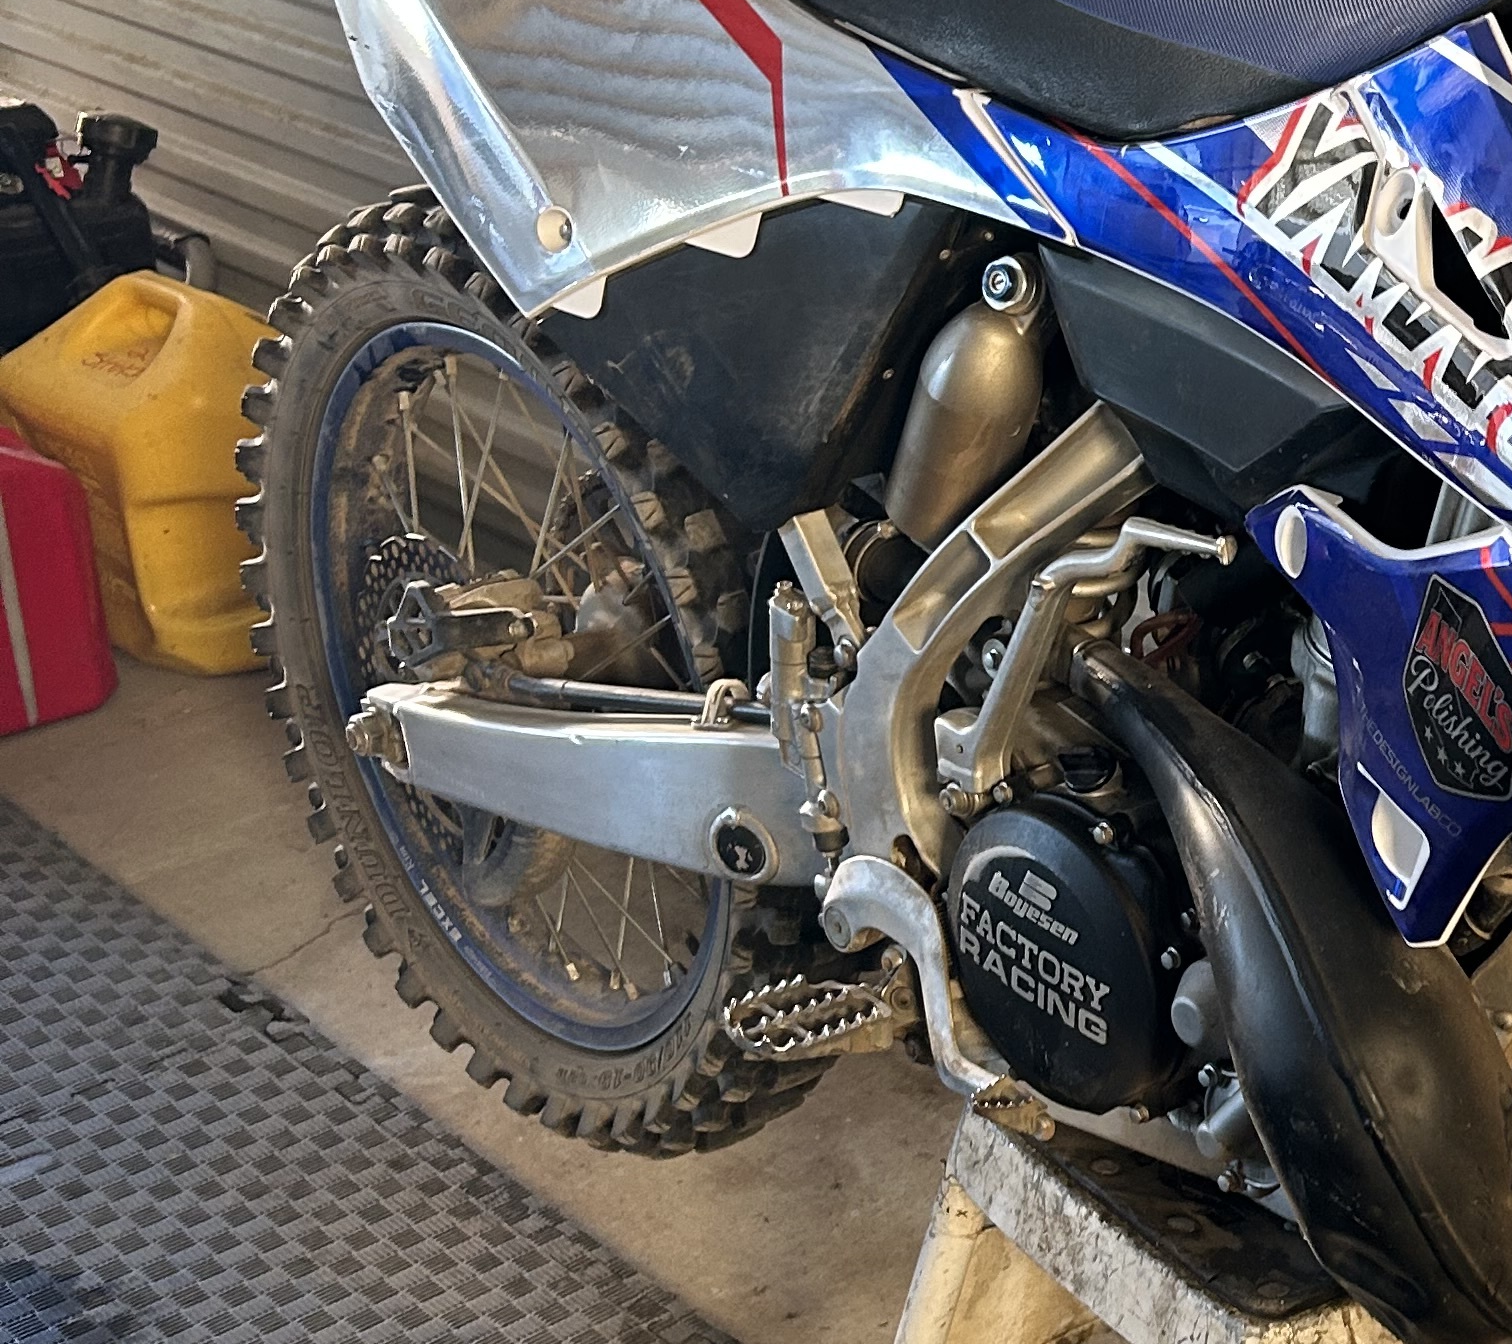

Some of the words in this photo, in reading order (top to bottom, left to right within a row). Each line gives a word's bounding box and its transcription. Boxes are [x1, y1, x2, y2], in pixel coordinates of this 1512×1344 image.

[1407, 655, 1509, 792] Polishing
[417, 879, 462, 942] EXCEL
[961, 892, 1111, 1011] FACTORY
[988, 870, 1079, 946] Boyesen
[960, 926, 1109, 1045] RACING
